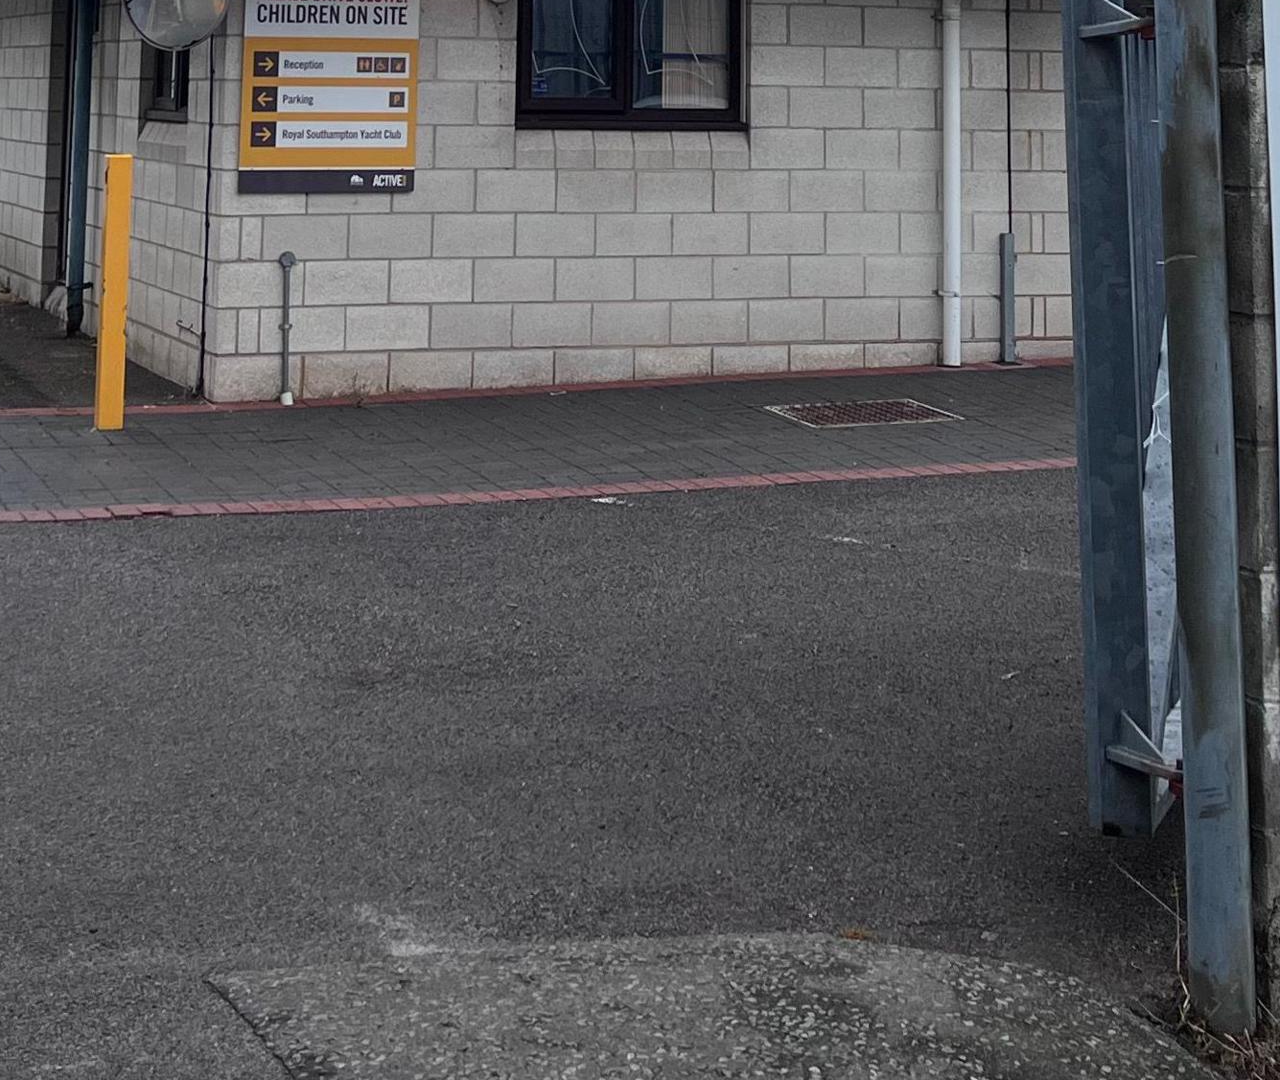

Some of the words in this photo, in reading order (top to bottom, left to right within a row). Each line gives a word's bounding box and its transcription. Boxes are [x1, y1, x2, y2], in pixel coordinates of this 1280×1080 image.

[257, 4, 340, 24] CHILDREN
[345, 6, 367, 24] ON
[373, 7, 408, 25] SITE
[283, 59, 324, 71] Reception
[282, 94, 314, 106] Parking
[282, 129, 304, 141] Royal
[306, 129, 358, 141] Southampton
[360, 130, 382, 140] Yacht
[384, 130, 402, 140] Club
